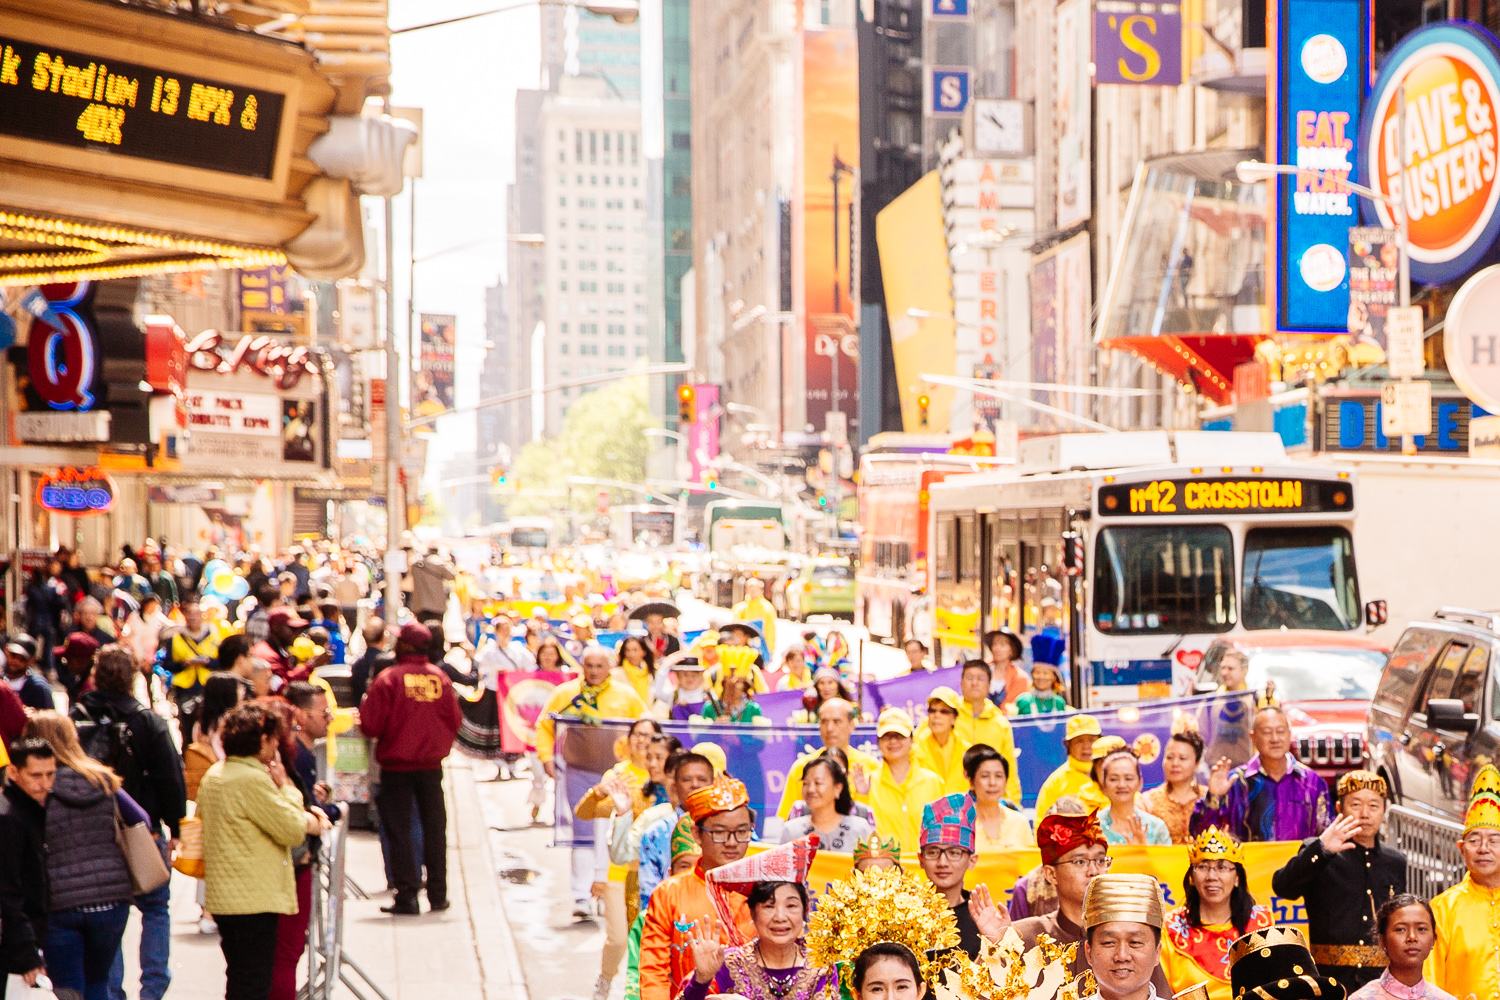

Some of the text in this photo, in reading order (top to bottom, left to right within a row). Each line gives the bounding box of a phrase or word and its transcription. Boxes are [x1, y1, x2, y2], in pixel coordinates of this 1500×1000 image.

[32, 52, 139, 108] Stadium
[151, 75, 181, 116] 13
[1384, 78, 1494, 178] DAVE &
[1386, 131, 1497, 222] BUSTER'S
[1130, 480, 1303, 513] M42 CROSSTOWN
